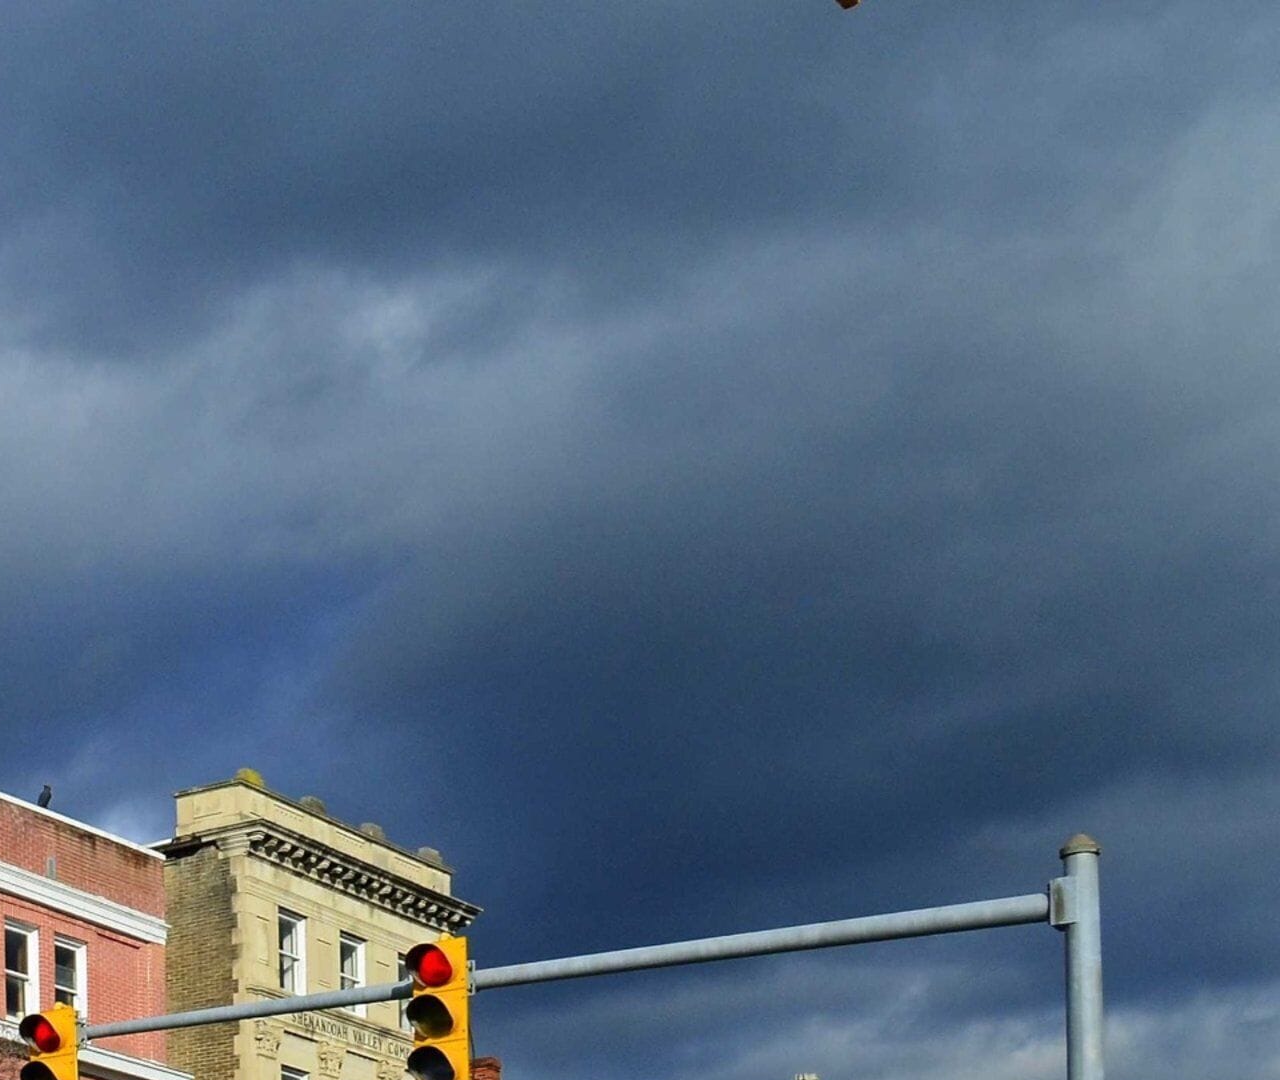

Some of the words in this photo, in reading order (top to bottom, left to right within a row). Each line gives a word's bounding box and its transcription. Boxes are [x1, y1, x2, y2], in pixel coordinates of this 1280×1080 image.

[291, 1012, 348, 1039] SHENANDOAH
[352, 1030, 383, 1051] VALLEY
[387, 1042, 411, 1058] COMP
